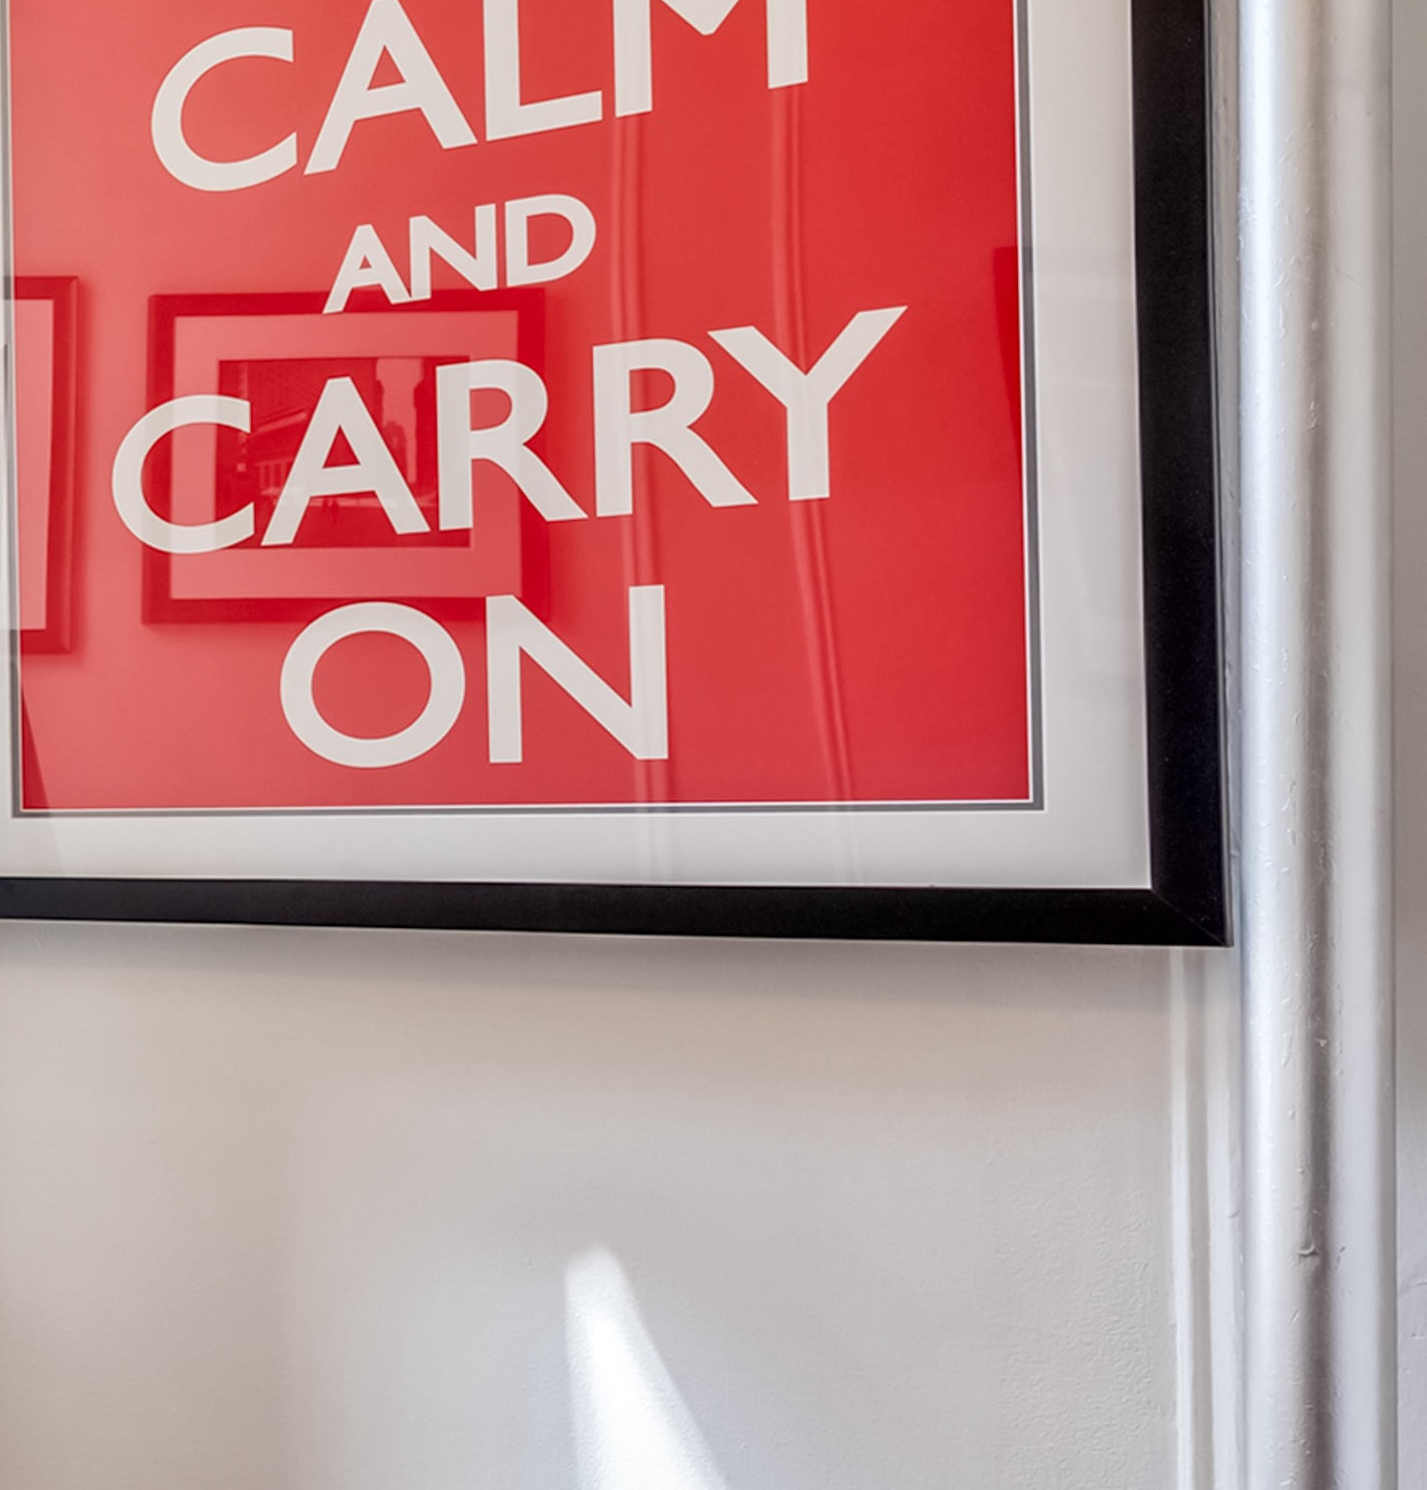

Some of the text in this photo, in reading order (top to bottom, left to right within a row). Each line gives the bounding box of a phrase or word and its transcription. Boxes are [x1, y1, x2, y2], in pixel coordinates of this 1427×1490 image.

[322, 194, 596, 314] AND
[111, 306, 907, 555] CARRY
[280, 584, 669, 767] ON
